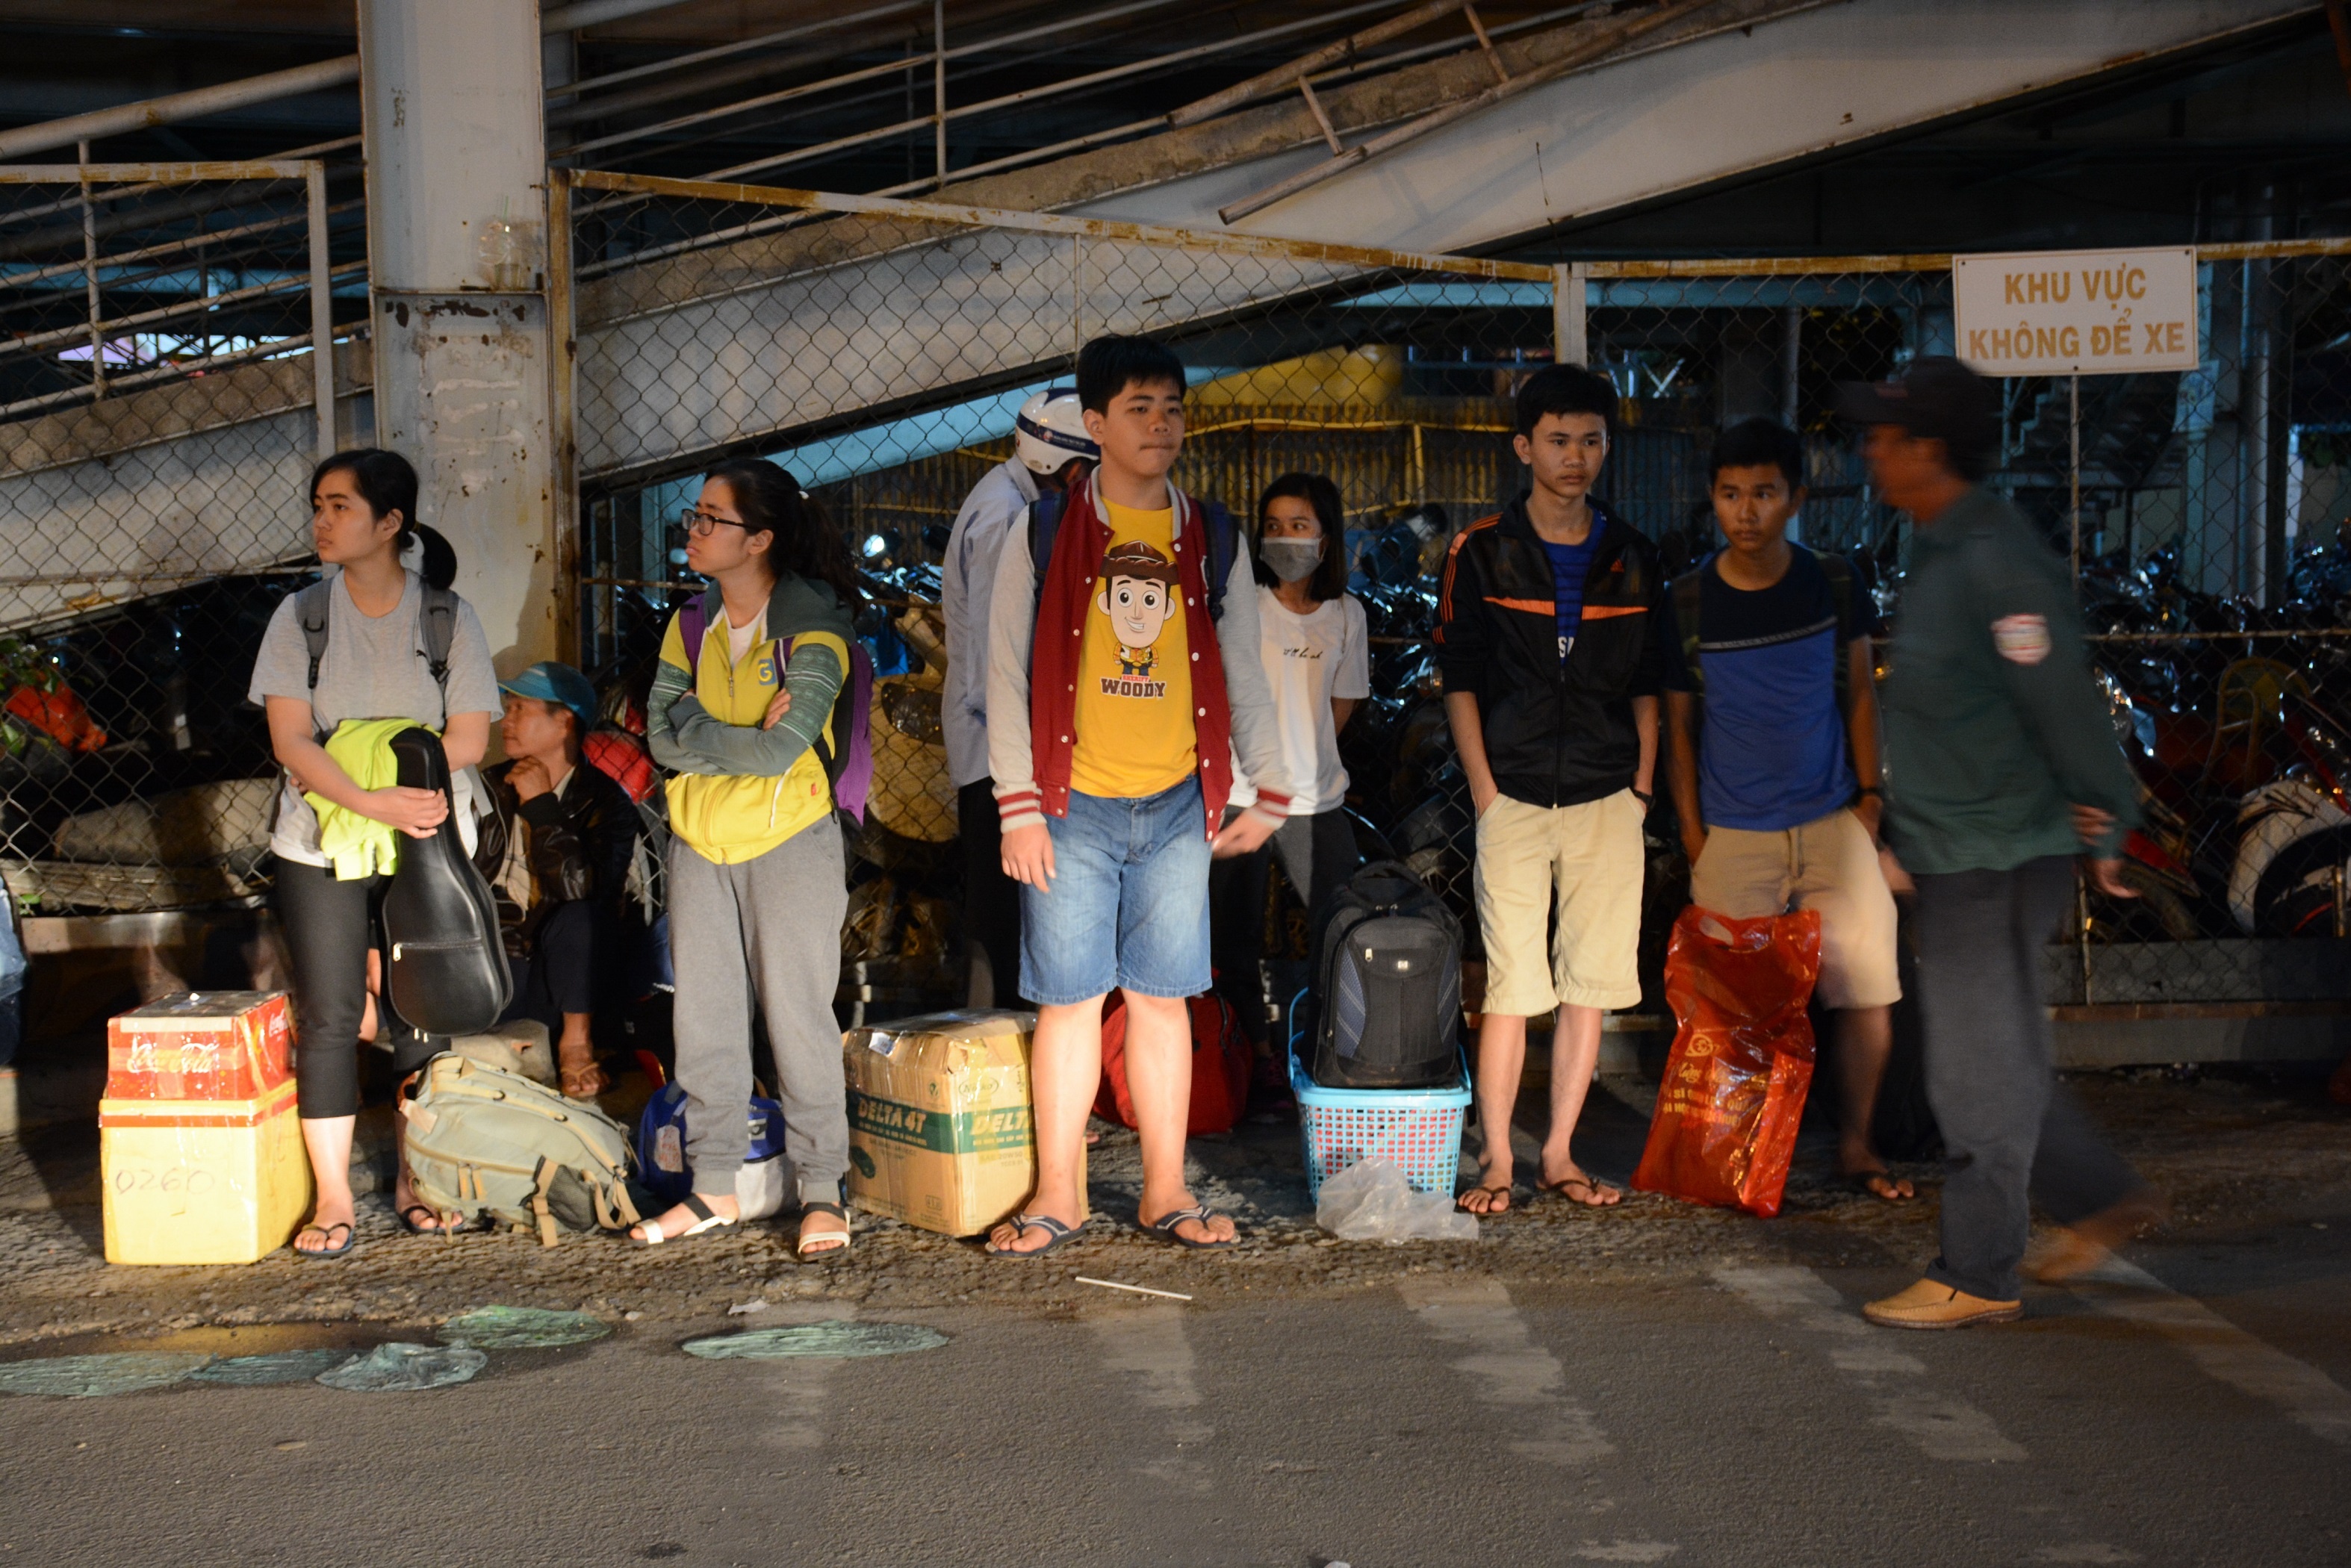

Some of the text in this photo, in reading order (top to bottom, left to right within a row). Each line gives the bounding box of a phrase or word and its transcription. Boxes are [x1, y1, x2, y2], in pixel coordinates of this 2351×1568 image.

[2004, 262, 2146, 310] KHU VỰC
[1969, 308, 2185, 359] KHÔNG ĐỂ XE
[1101, 678, 1166, 697] WOODY
[857, 1098, 902, 1128] DELTA
[115, 1168, 215, 1194] 0260
